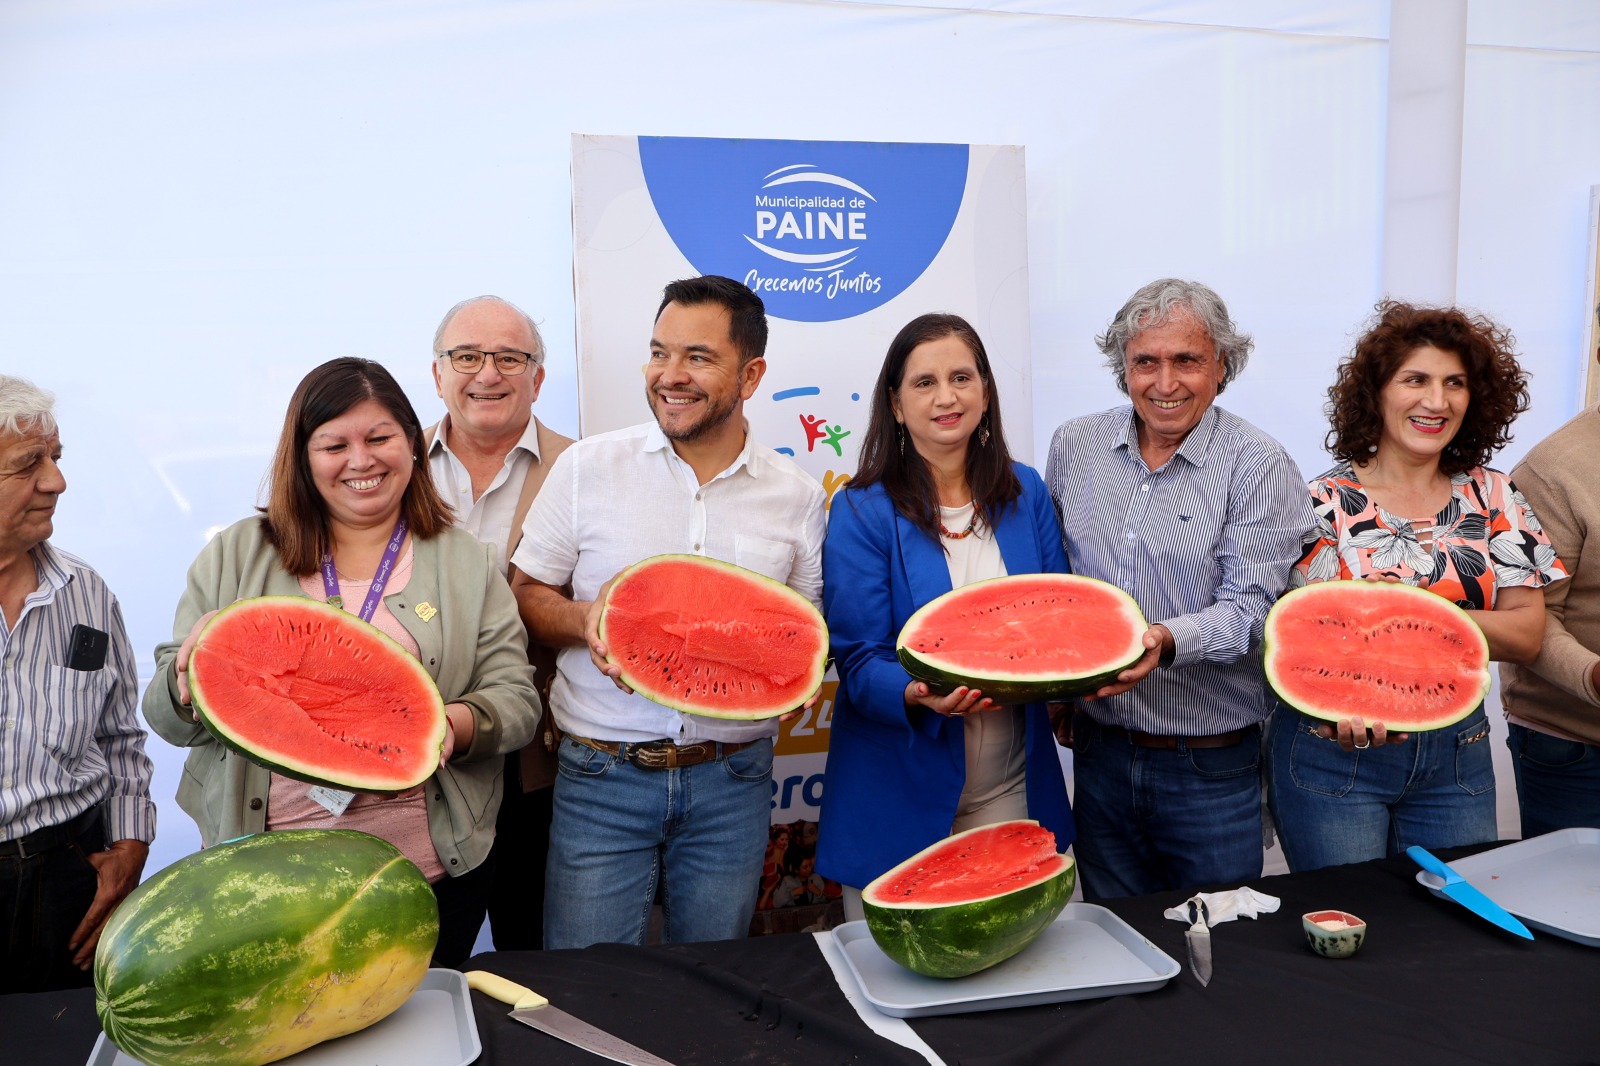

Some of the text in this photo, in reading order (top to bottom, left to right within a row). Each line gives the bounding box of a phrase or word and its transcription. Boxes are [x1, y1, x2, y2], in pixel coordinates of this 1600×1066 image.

[755, 195, 866, 209] Municipalidad de
[756, 211, 867, 240] PAINE
[744, 269, 881, 299] Crecemos Juntos
